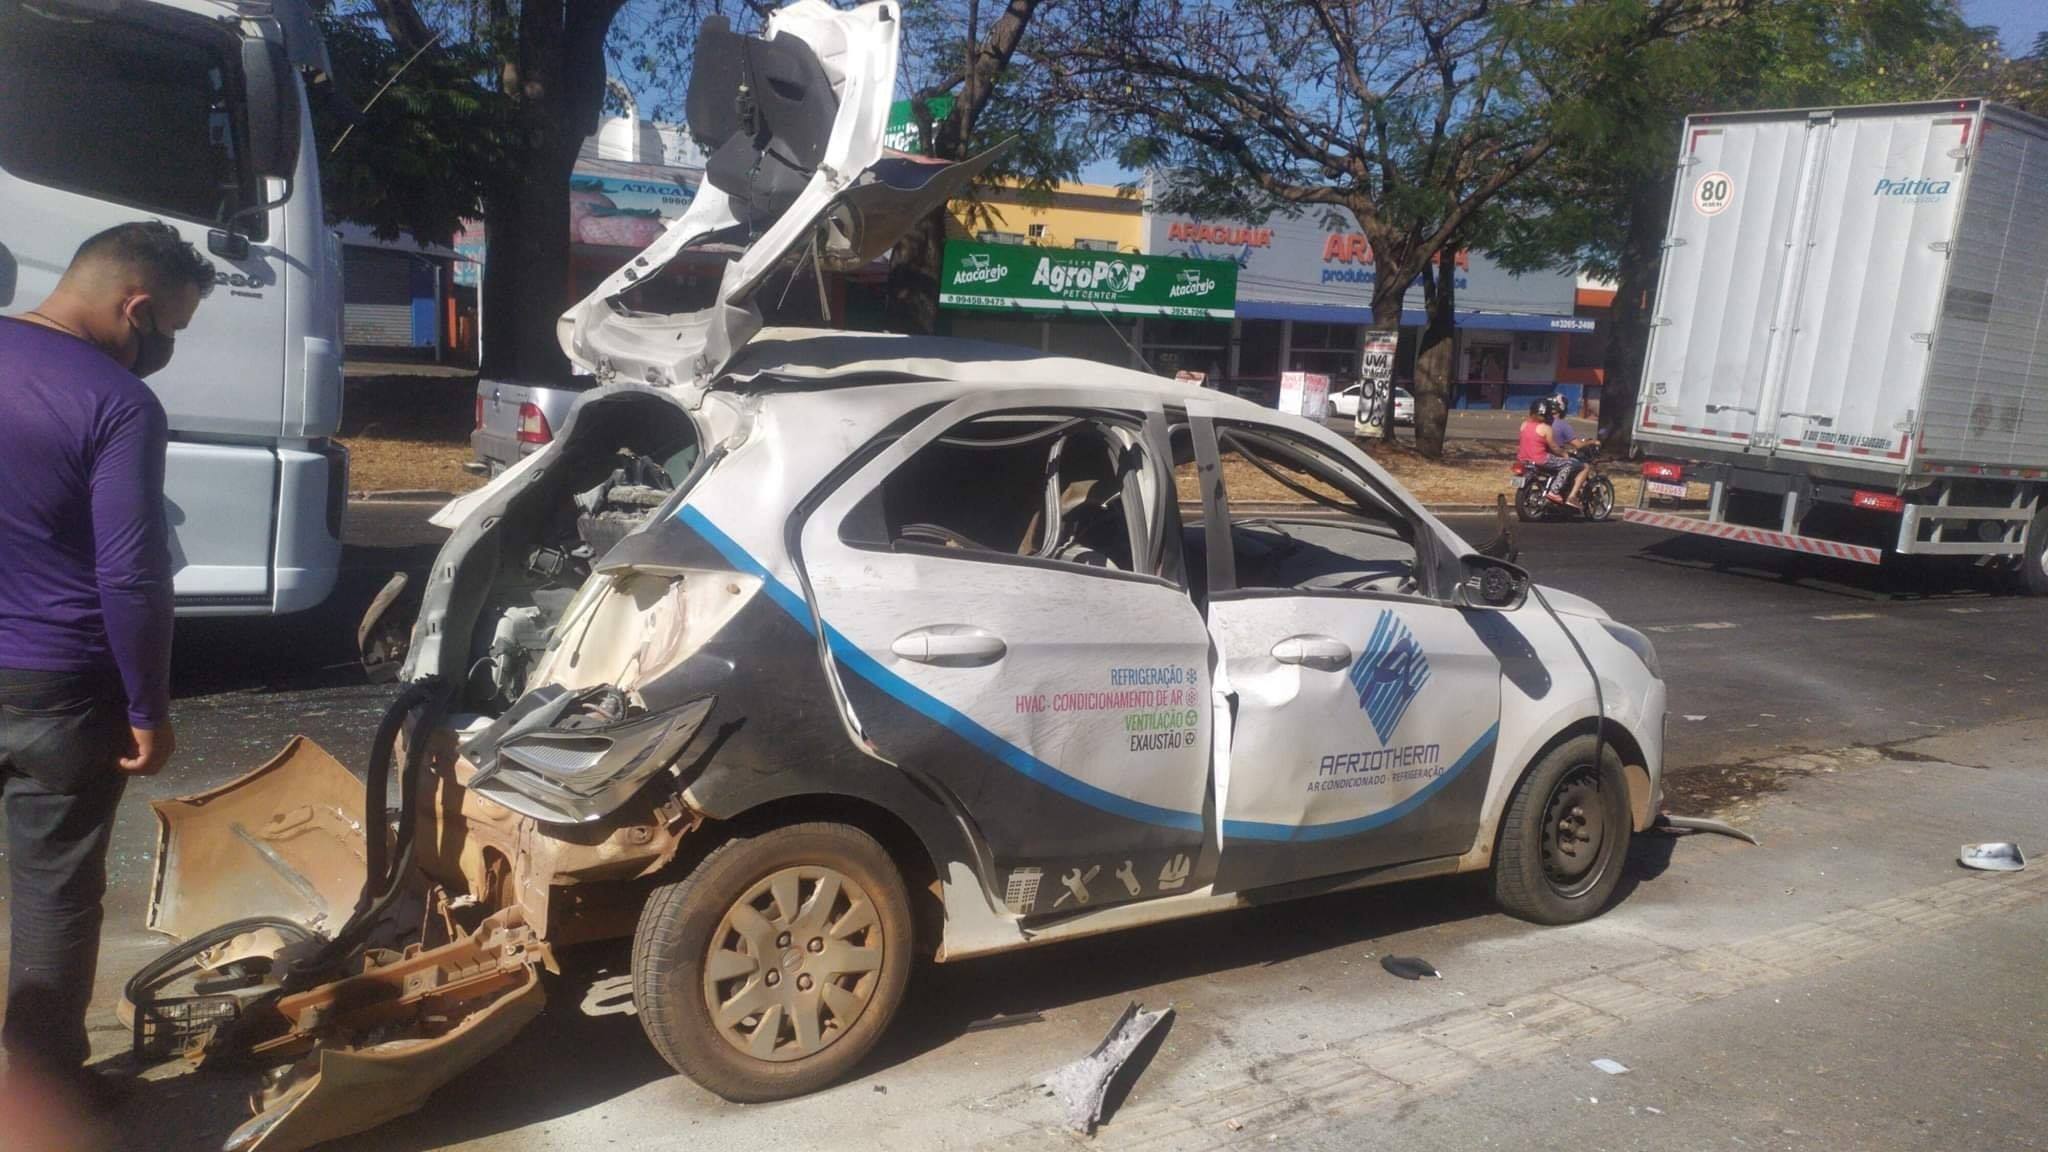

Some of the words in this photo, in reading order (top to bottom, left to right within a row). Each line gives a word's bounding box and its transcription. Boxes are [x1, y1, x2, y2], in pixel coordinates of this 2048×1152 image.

[1701, 180, 1728, 202] 80
[1873, 177, 1952, 196] Práttica
[1168, 223, 1274, 249] ARAGUAIA
[952, 263, 1009, 286] Atacarejo
[1062, 289, 1081, 298] PET
[1081, 290, 1118, 300] CENTER
[1168, 278, 1216, 299] Atacarejo
[1366, 354, 1388, 368] UVA
[1358, 379, 1376, 424] 9
[1111, 665, 1183, 688] REFRIGERAÇÃO
[1015, 694, 1046, 713] HVAC
[1053, 690, 1154, 712] CONDICIONAMENTO
[1155, 690, 1169, 706] DE
[1170, 688, 1183, 705] AR
[1125, 709, 1183, 731] VENTILAÇÃO
[1130, 730, 1182, 752] EXAUSTÃO
[1319, 744, 1440, 776] AFRIOTHERM
[1307, 782, 1320, 792] AR
[1321, 774, 1386, 791] CONDICIONADO
[1392, 765, 1445, 782] REFRIGERAÇÃO
